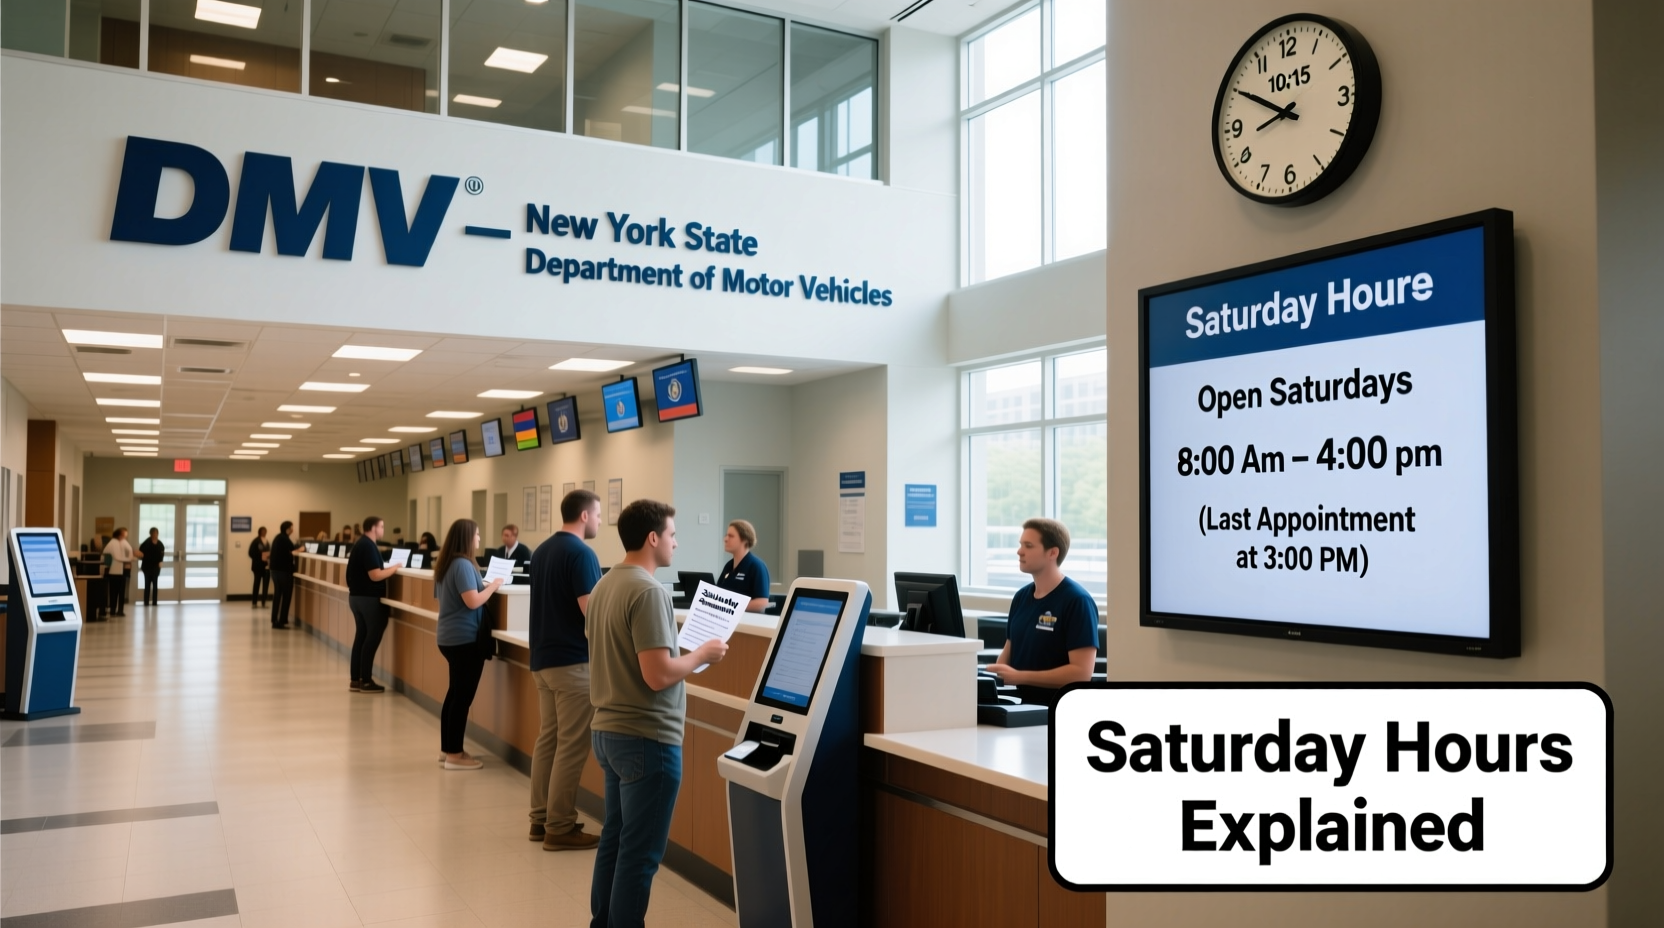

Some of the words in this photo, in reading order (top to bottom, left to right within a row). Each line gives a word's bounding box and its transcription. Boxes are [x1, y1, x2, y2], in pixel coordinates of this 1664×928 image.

[1279, 36, 1297, 59] 12
[1268, 64, 1311, 93] 10:15
[1337, 85, 1350, 107] 3
[1231, 118, 1243, 139] 9
[1260, 163, 1271, 183] 7
[1284, 163, 1297, 185] 6
[110, 135, 461, 268] DMV
[526, 203, 599, 240] New
[606, 211, 676, 249] York
[684, 221, 758, 257] State
[525, 247, 683, 284] Department
[689, 265, 716, 291] of
[722, 267, 794, 298] Motor
[799, 274, 893, 307] Vehicles
[1185, 290, 1318, 339] Saturday
[1327, 272, 1434, 316] Houre
[1197, 384, 1263, 419] Open
[1269, 367, 1413, 405] Saturdays
[1177, 446, 1235, 477] 8:00
[1240, 444, 1285, 474] Am
[1316, 434, 1388, 471] 4:00
[1395, 443, 1442, 476] pm
[1198, 504, 1252, 537] (Last
[1256, 503, 1416, 538] Appointment
[1236, 545, 1258, 569] at
[1263, 545, 1313, 571] 3:00
[1320, 543, 1369, 579] PM)
